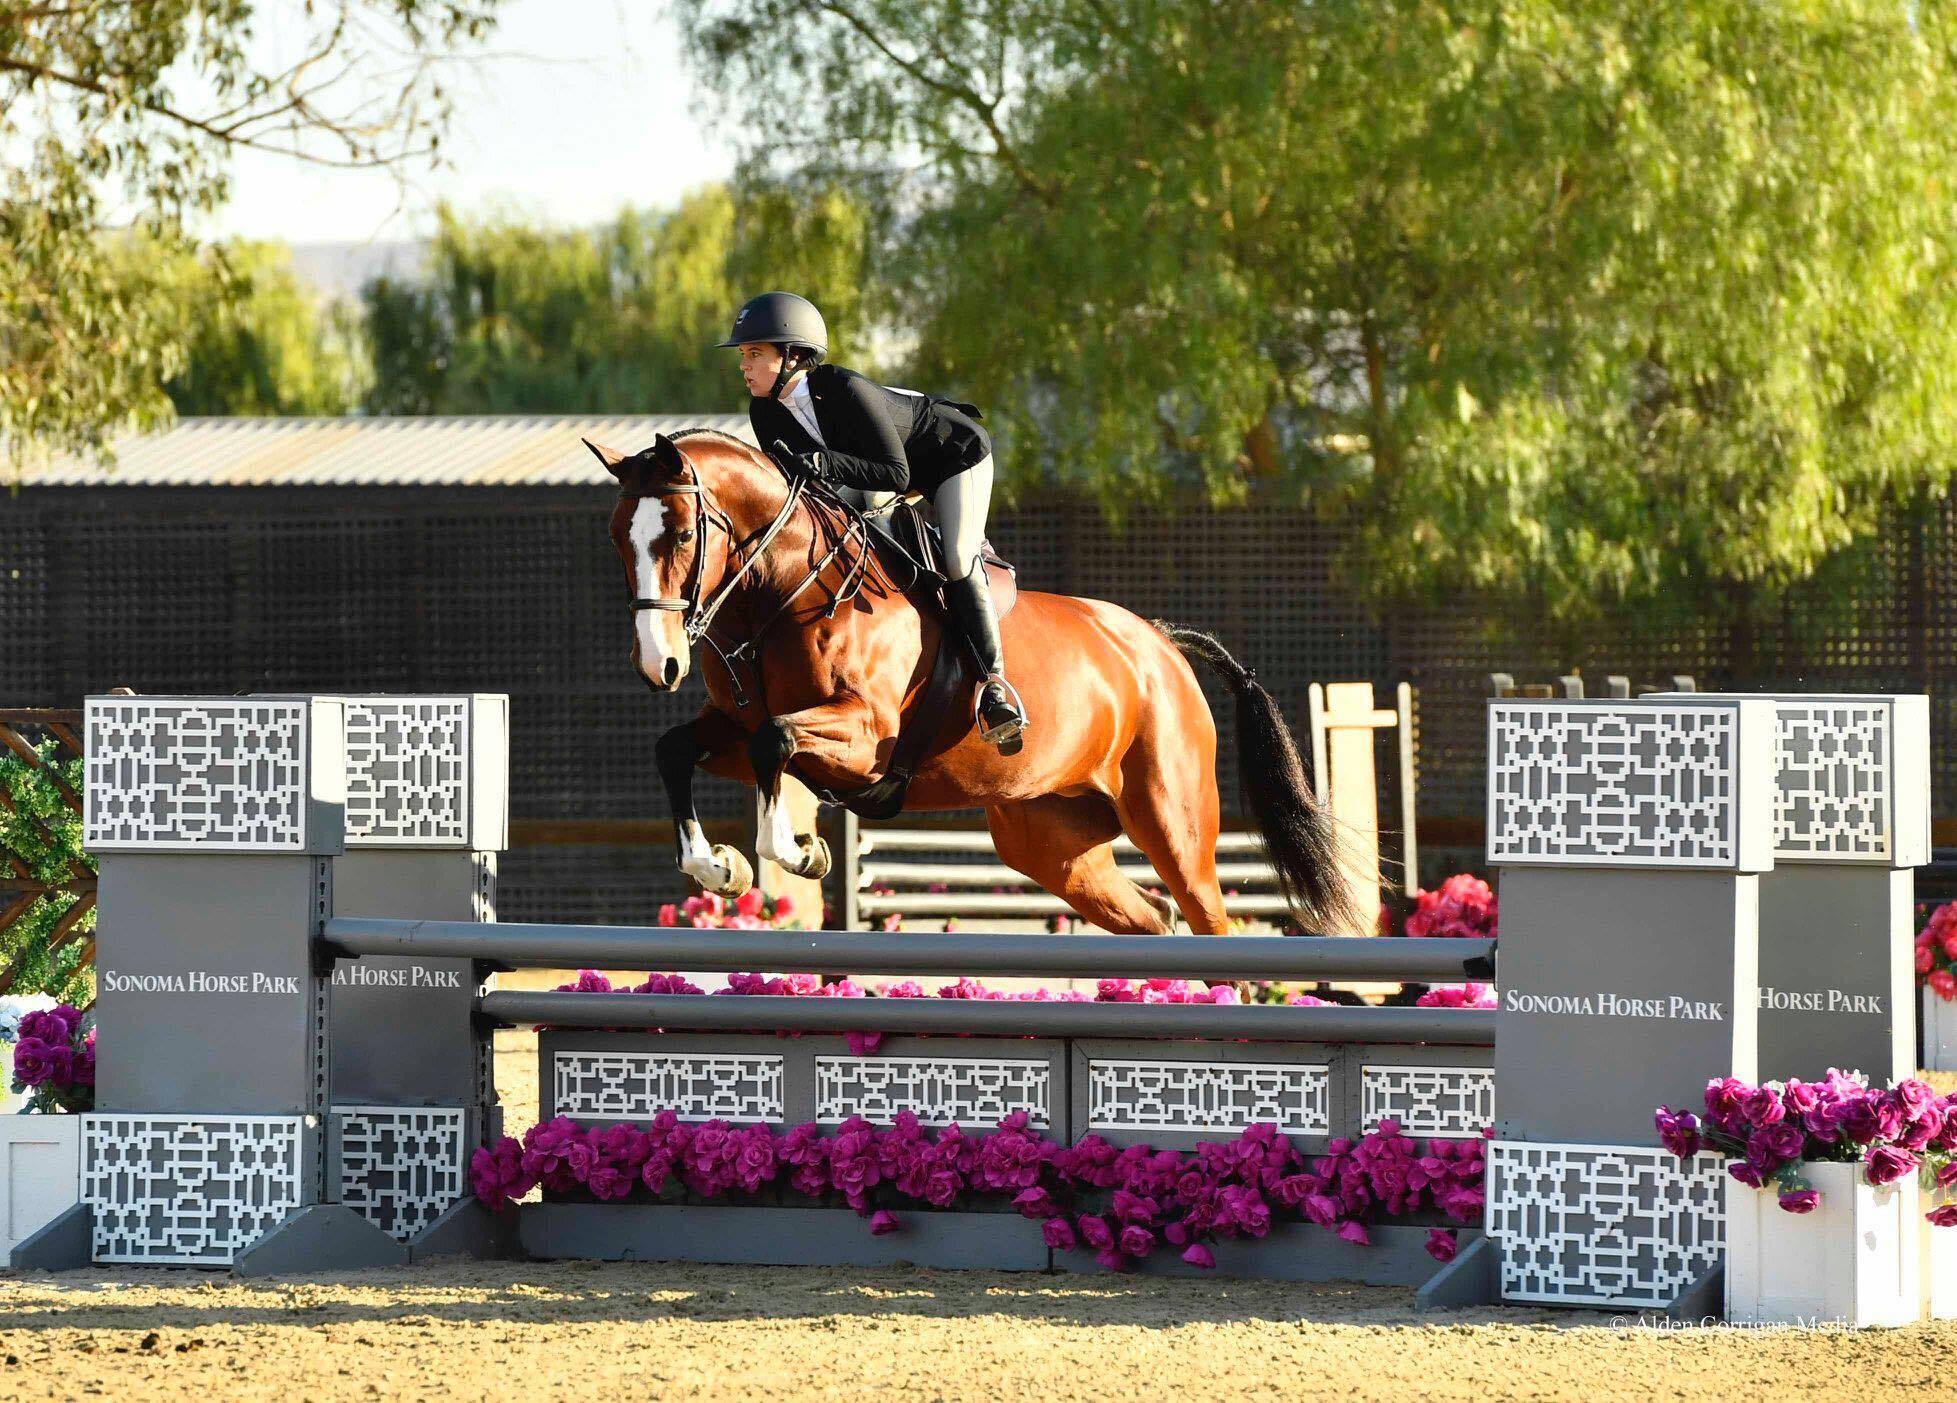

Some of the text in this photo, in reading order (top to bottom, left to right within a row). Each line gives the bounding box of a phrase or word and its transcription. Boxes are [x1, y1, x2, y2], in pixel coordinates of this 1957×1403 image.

[104, 970, 300, 994] SONOMA HORSE PARK
[350, 965, 408, 987] HORSE
[410, 966, 461, 988] PARK
[1506, 989, 1723, 1021] SONOMA HORSE PARK
[1757, 986, 1883, 1014] HORSE PARK
